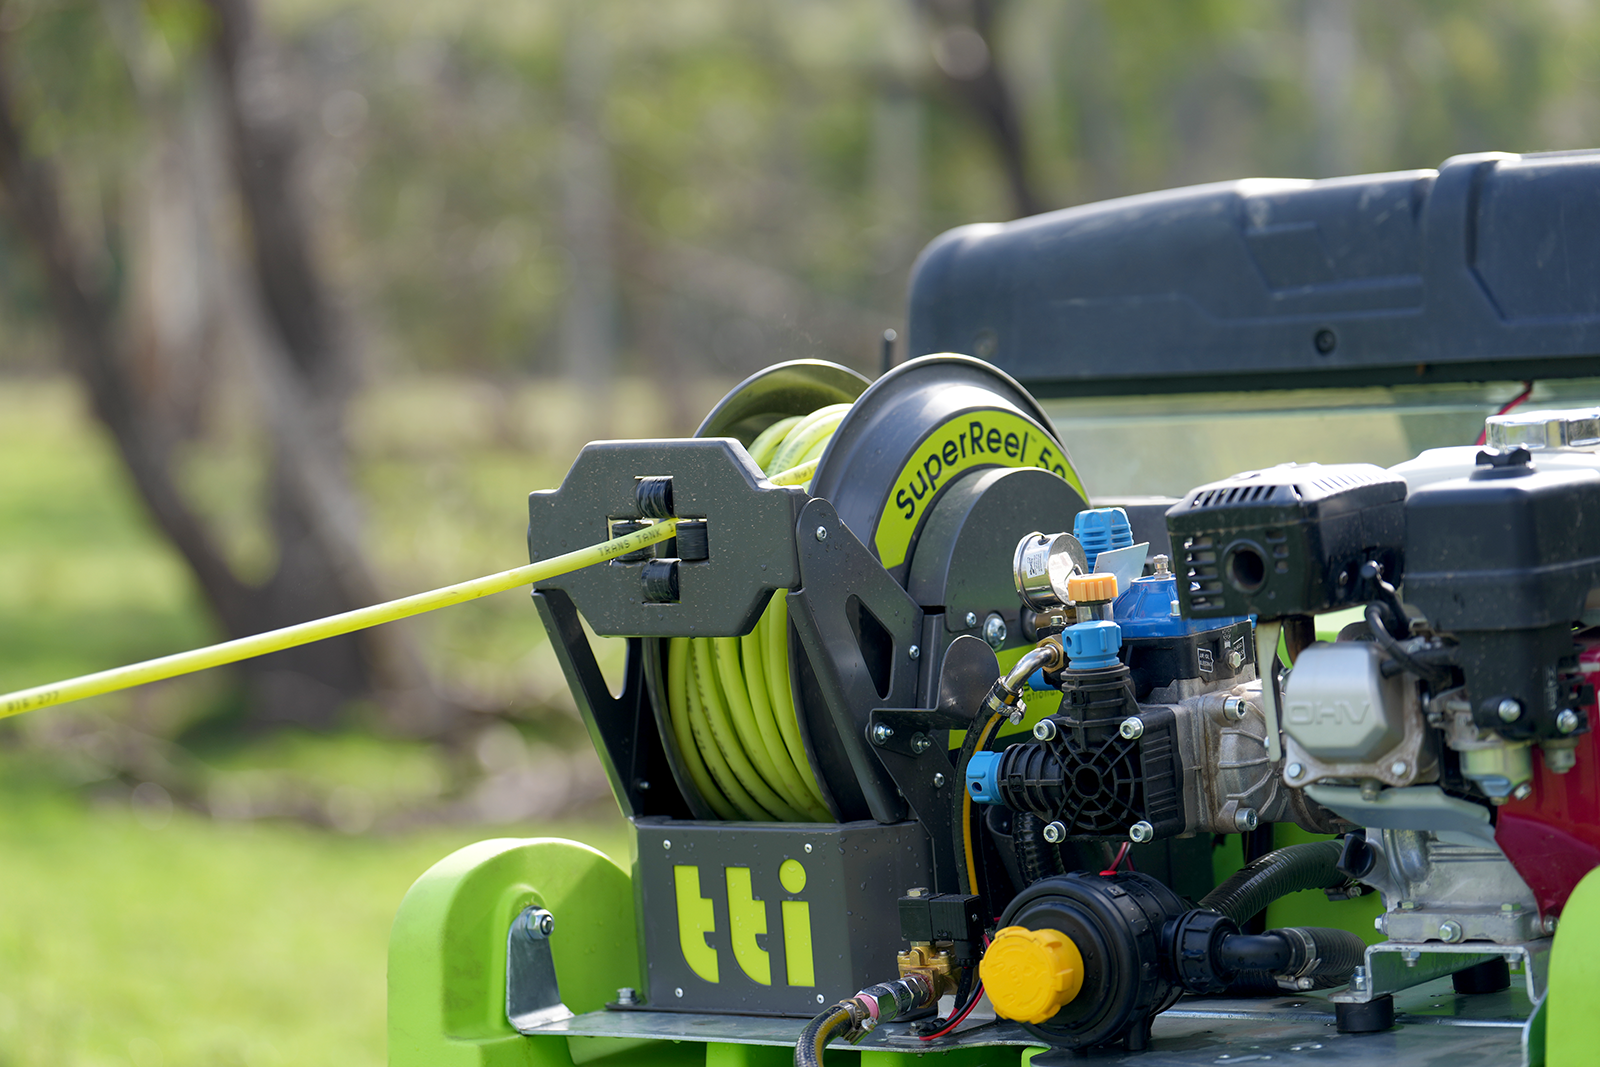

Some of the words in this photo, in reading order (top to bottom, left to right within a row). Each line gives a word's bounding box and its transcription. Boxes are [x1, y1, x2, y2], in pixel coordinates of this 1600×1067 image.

[896, 421, 1029, 520] superReel
[597, 539, 631, 557] TRANS
[635, 528, 663, 545] TANK
[37, 691, 59, 705] 277
[1287, 700, 1371, 726] OHV
[673, 859, 816, 988] tti
